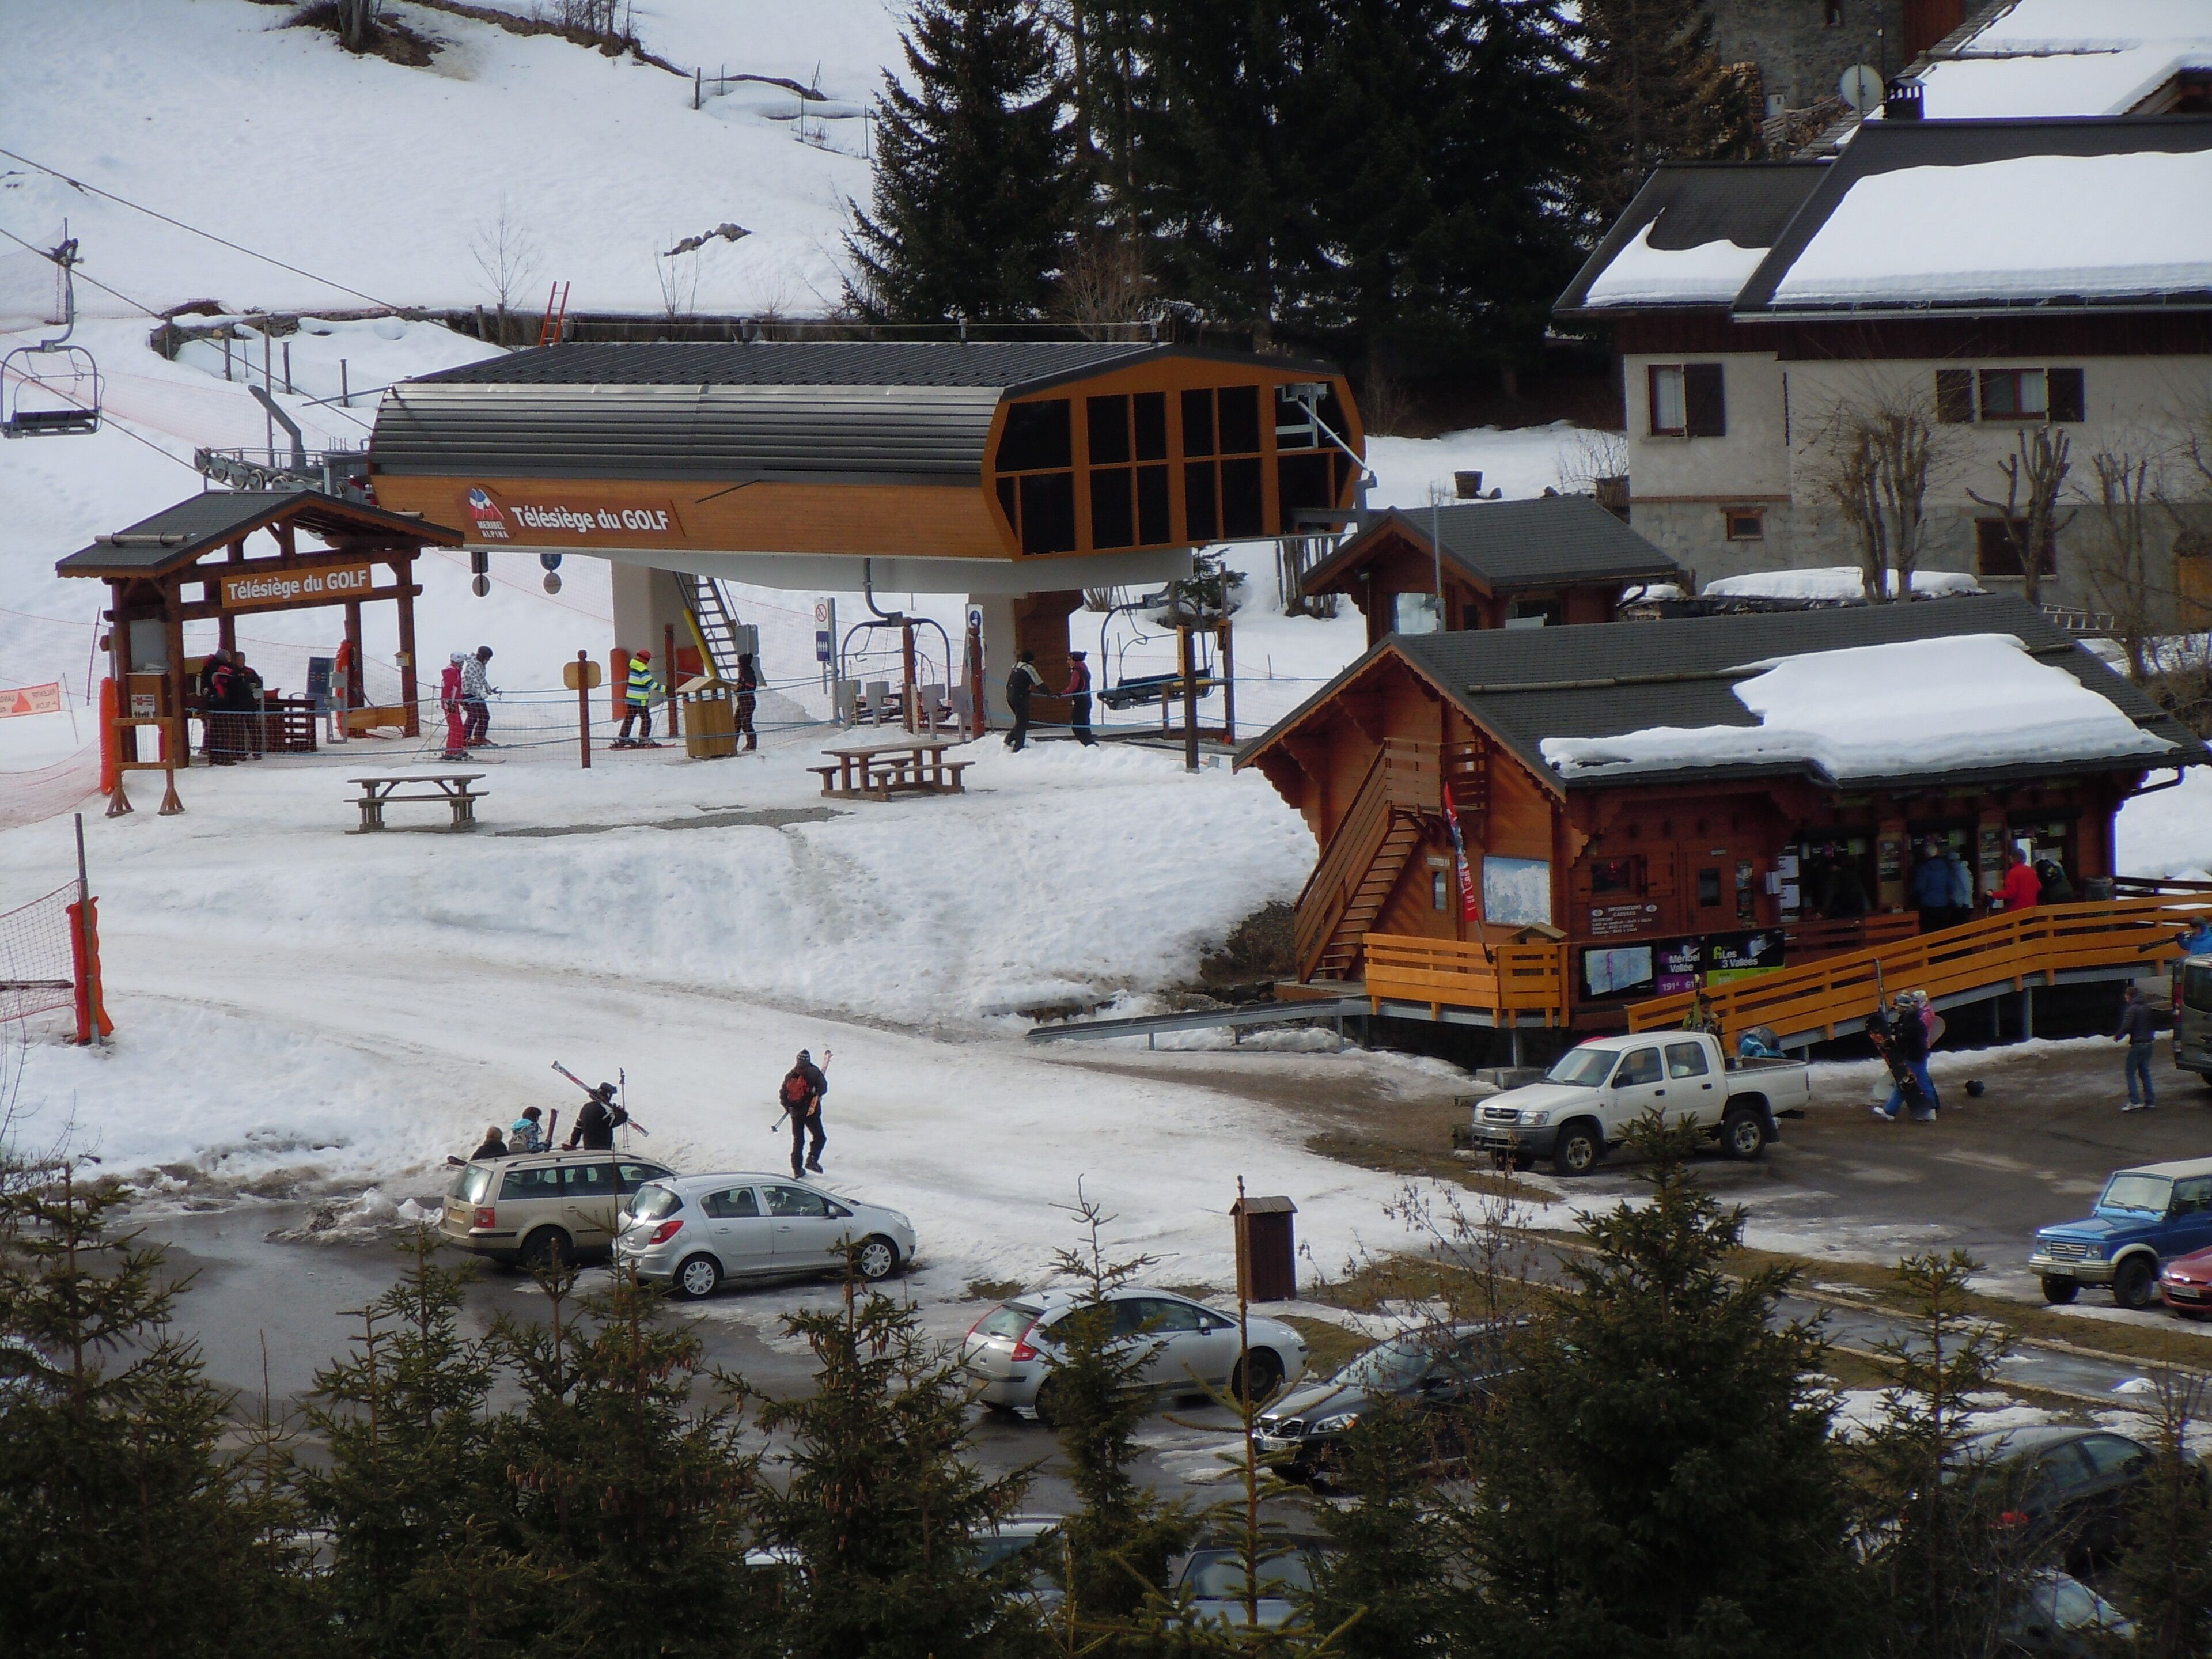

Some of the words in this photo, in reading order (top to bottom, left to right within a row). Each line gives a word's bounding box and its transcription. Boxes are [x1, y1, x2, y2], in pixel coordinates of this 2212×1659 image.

[510, 505, 596, 533] Télésiège
[597, 508, 622, 529] du
[622, 509, 669, 531] GOLF
[476, 520, 506, 529] MERIBEL
[482, 529, 509, 539] ALPINA
[228, 577, 300, 599] Télésiège
[303, 574, 323, 593] du
[327, 570, 366, 591] GOLF
[1669, 952, 1700, 964] Méribel
[1722, 950, 1737, 959] Les
[1722, 959, 1729, 968] 3
[1730, 957, 1758, 967] Vallées
[1670, 963, 1694, 973] Vallée
